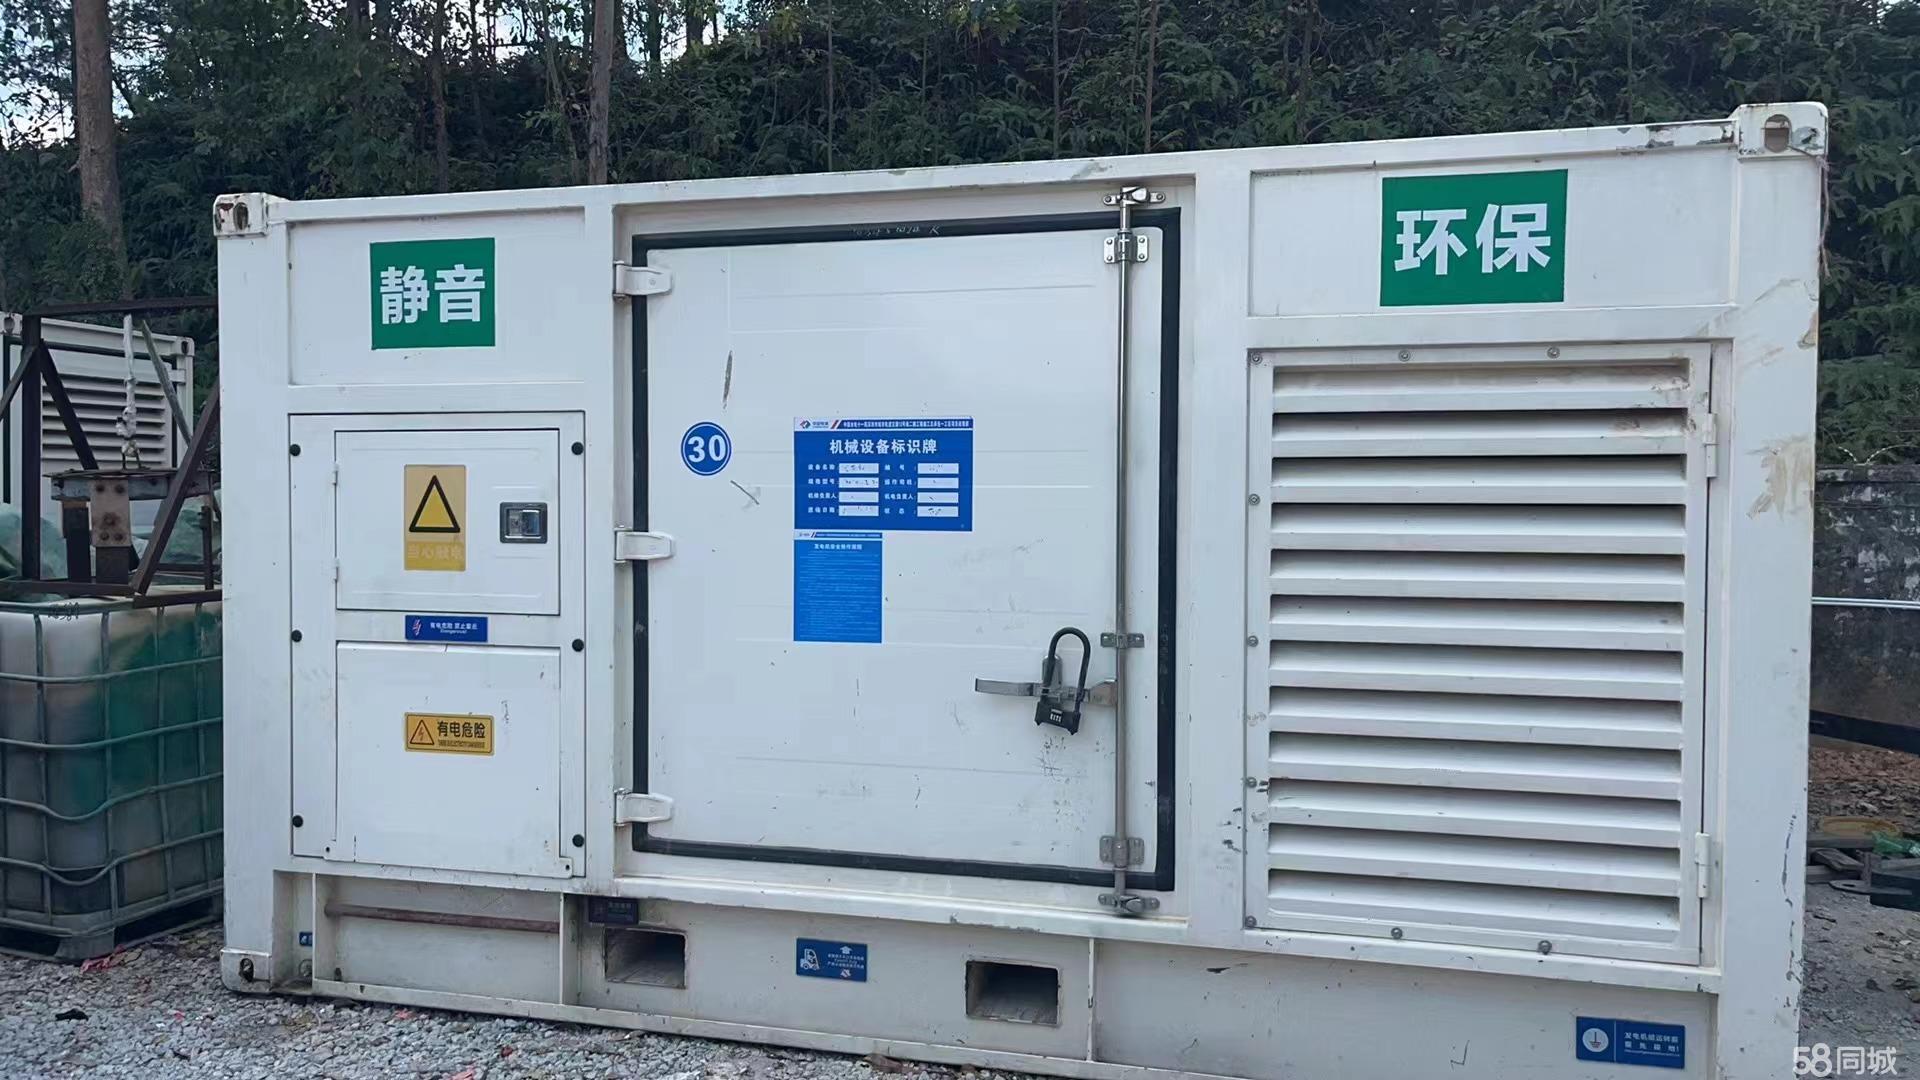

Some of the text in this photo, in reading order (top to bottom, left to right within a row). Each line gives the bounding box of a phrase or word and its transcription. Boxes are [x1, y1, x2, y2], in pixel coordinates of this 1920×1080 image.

[1394, 203, 1551, 275] 环保
[380, 264, 485, 324] 静音
[688, 435, 726, 463] 30
[829, 439, 938, 454] 机械设备标识牌
[437, 720, 486, 738] 有电危险
